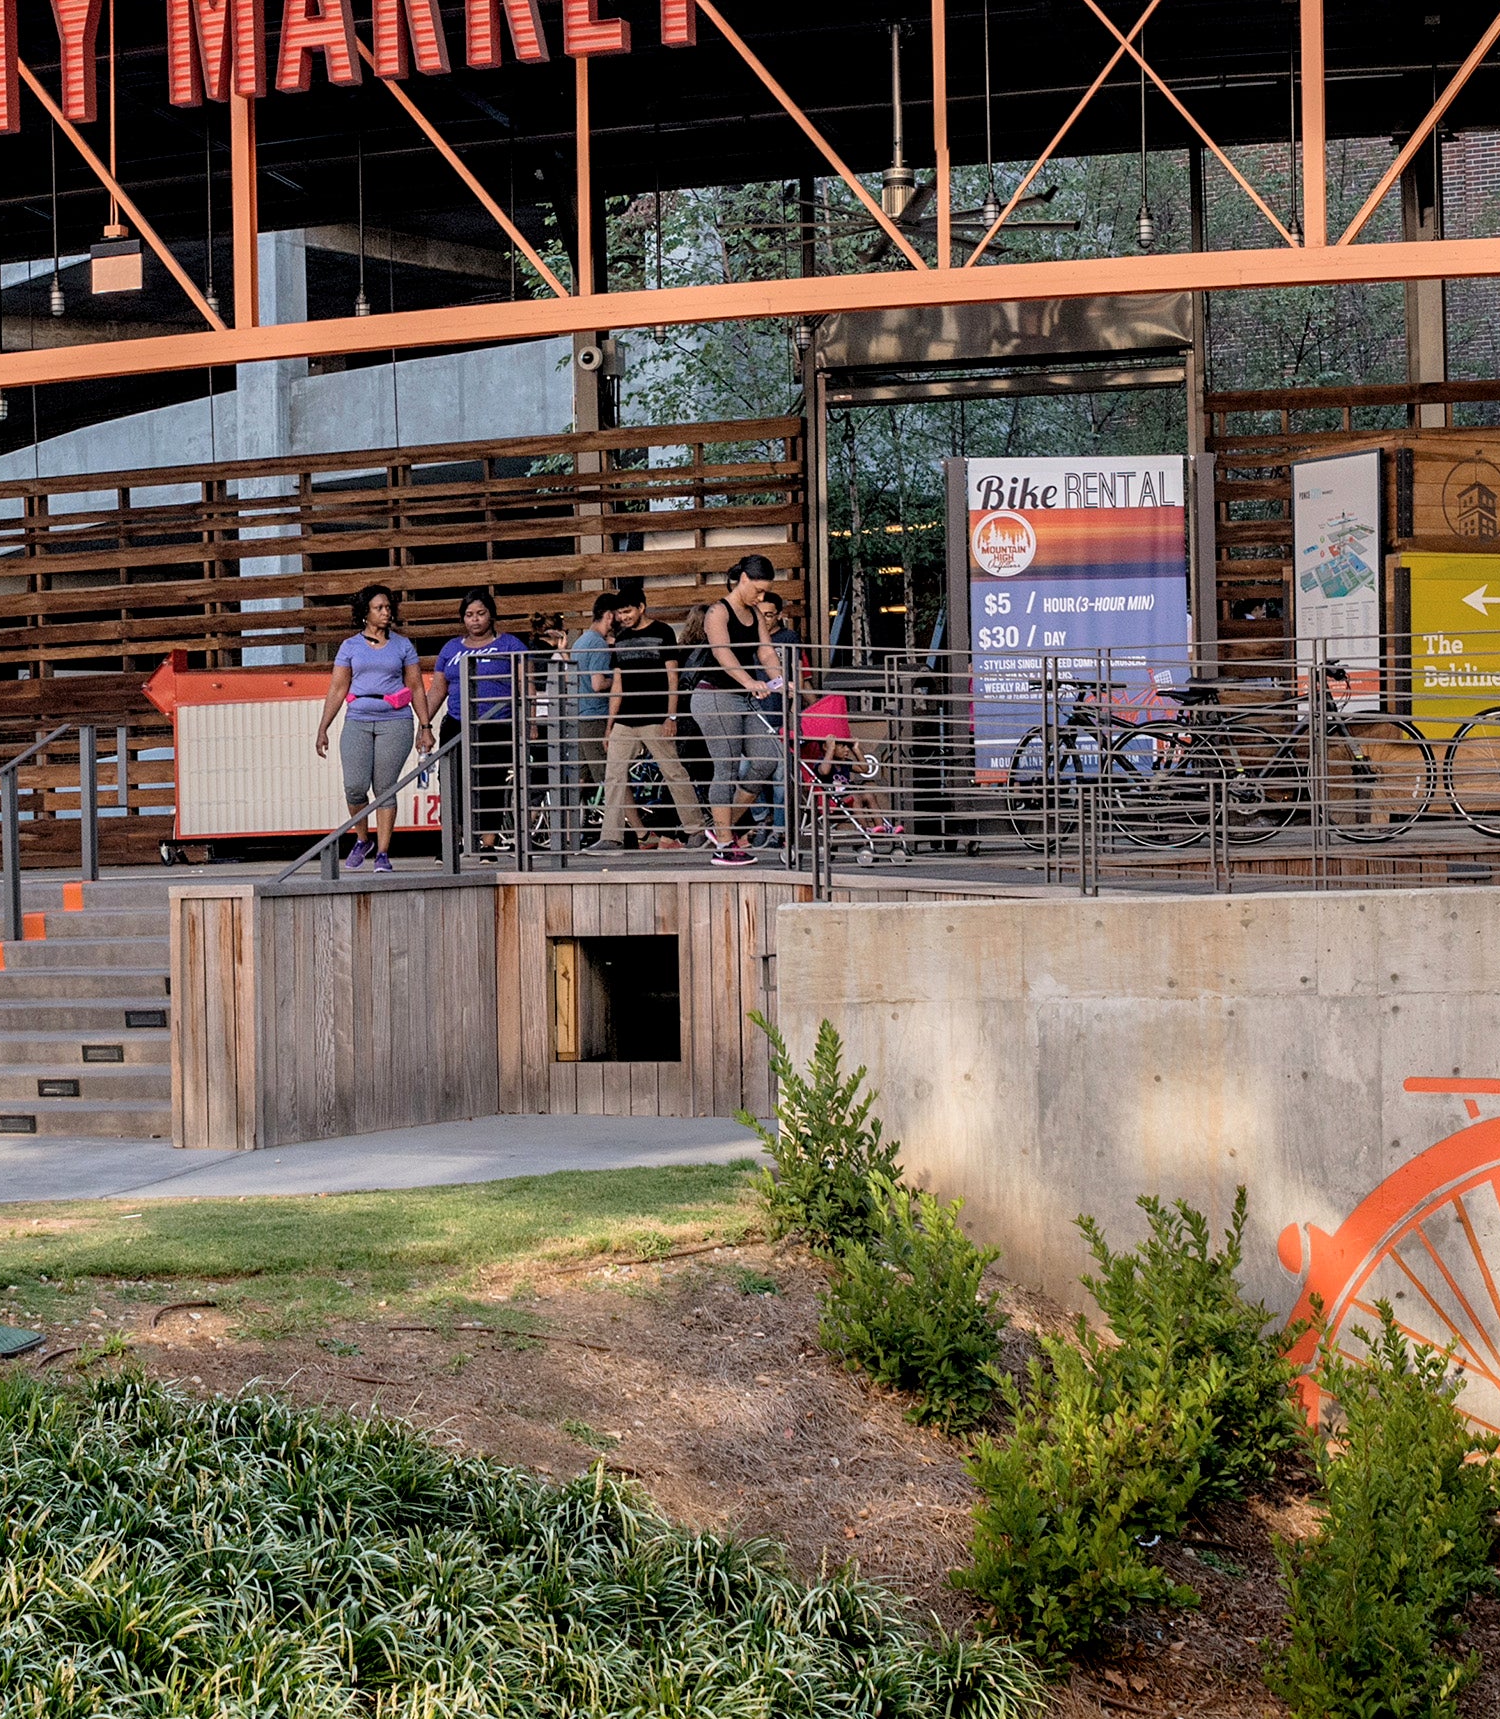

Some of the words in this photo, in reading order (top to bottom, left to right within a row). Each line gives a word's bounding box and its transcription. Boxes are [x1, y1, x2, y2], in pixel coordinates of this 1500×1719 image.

[976, 475, 1058, 510] Bike
[1064, 471, 1175, 508] RENTAL
[981, 546, 1026, 554] MOUNTAIN
[993, 553, 1015, 561] HIGH
[984, 592, 1011, 616] $5
[1043, 597, 1075, 613] HOUR
[1127, 594, 1155, 611] MIN)
[978, 625, 1020, 650] $30
[1044, 631, 1067, 647] DAY
[1423, 631, 1463, 655] The
[983, 659, 1016, 670] STYLISH
[984, 682, 1013, 693] WEEKLY
